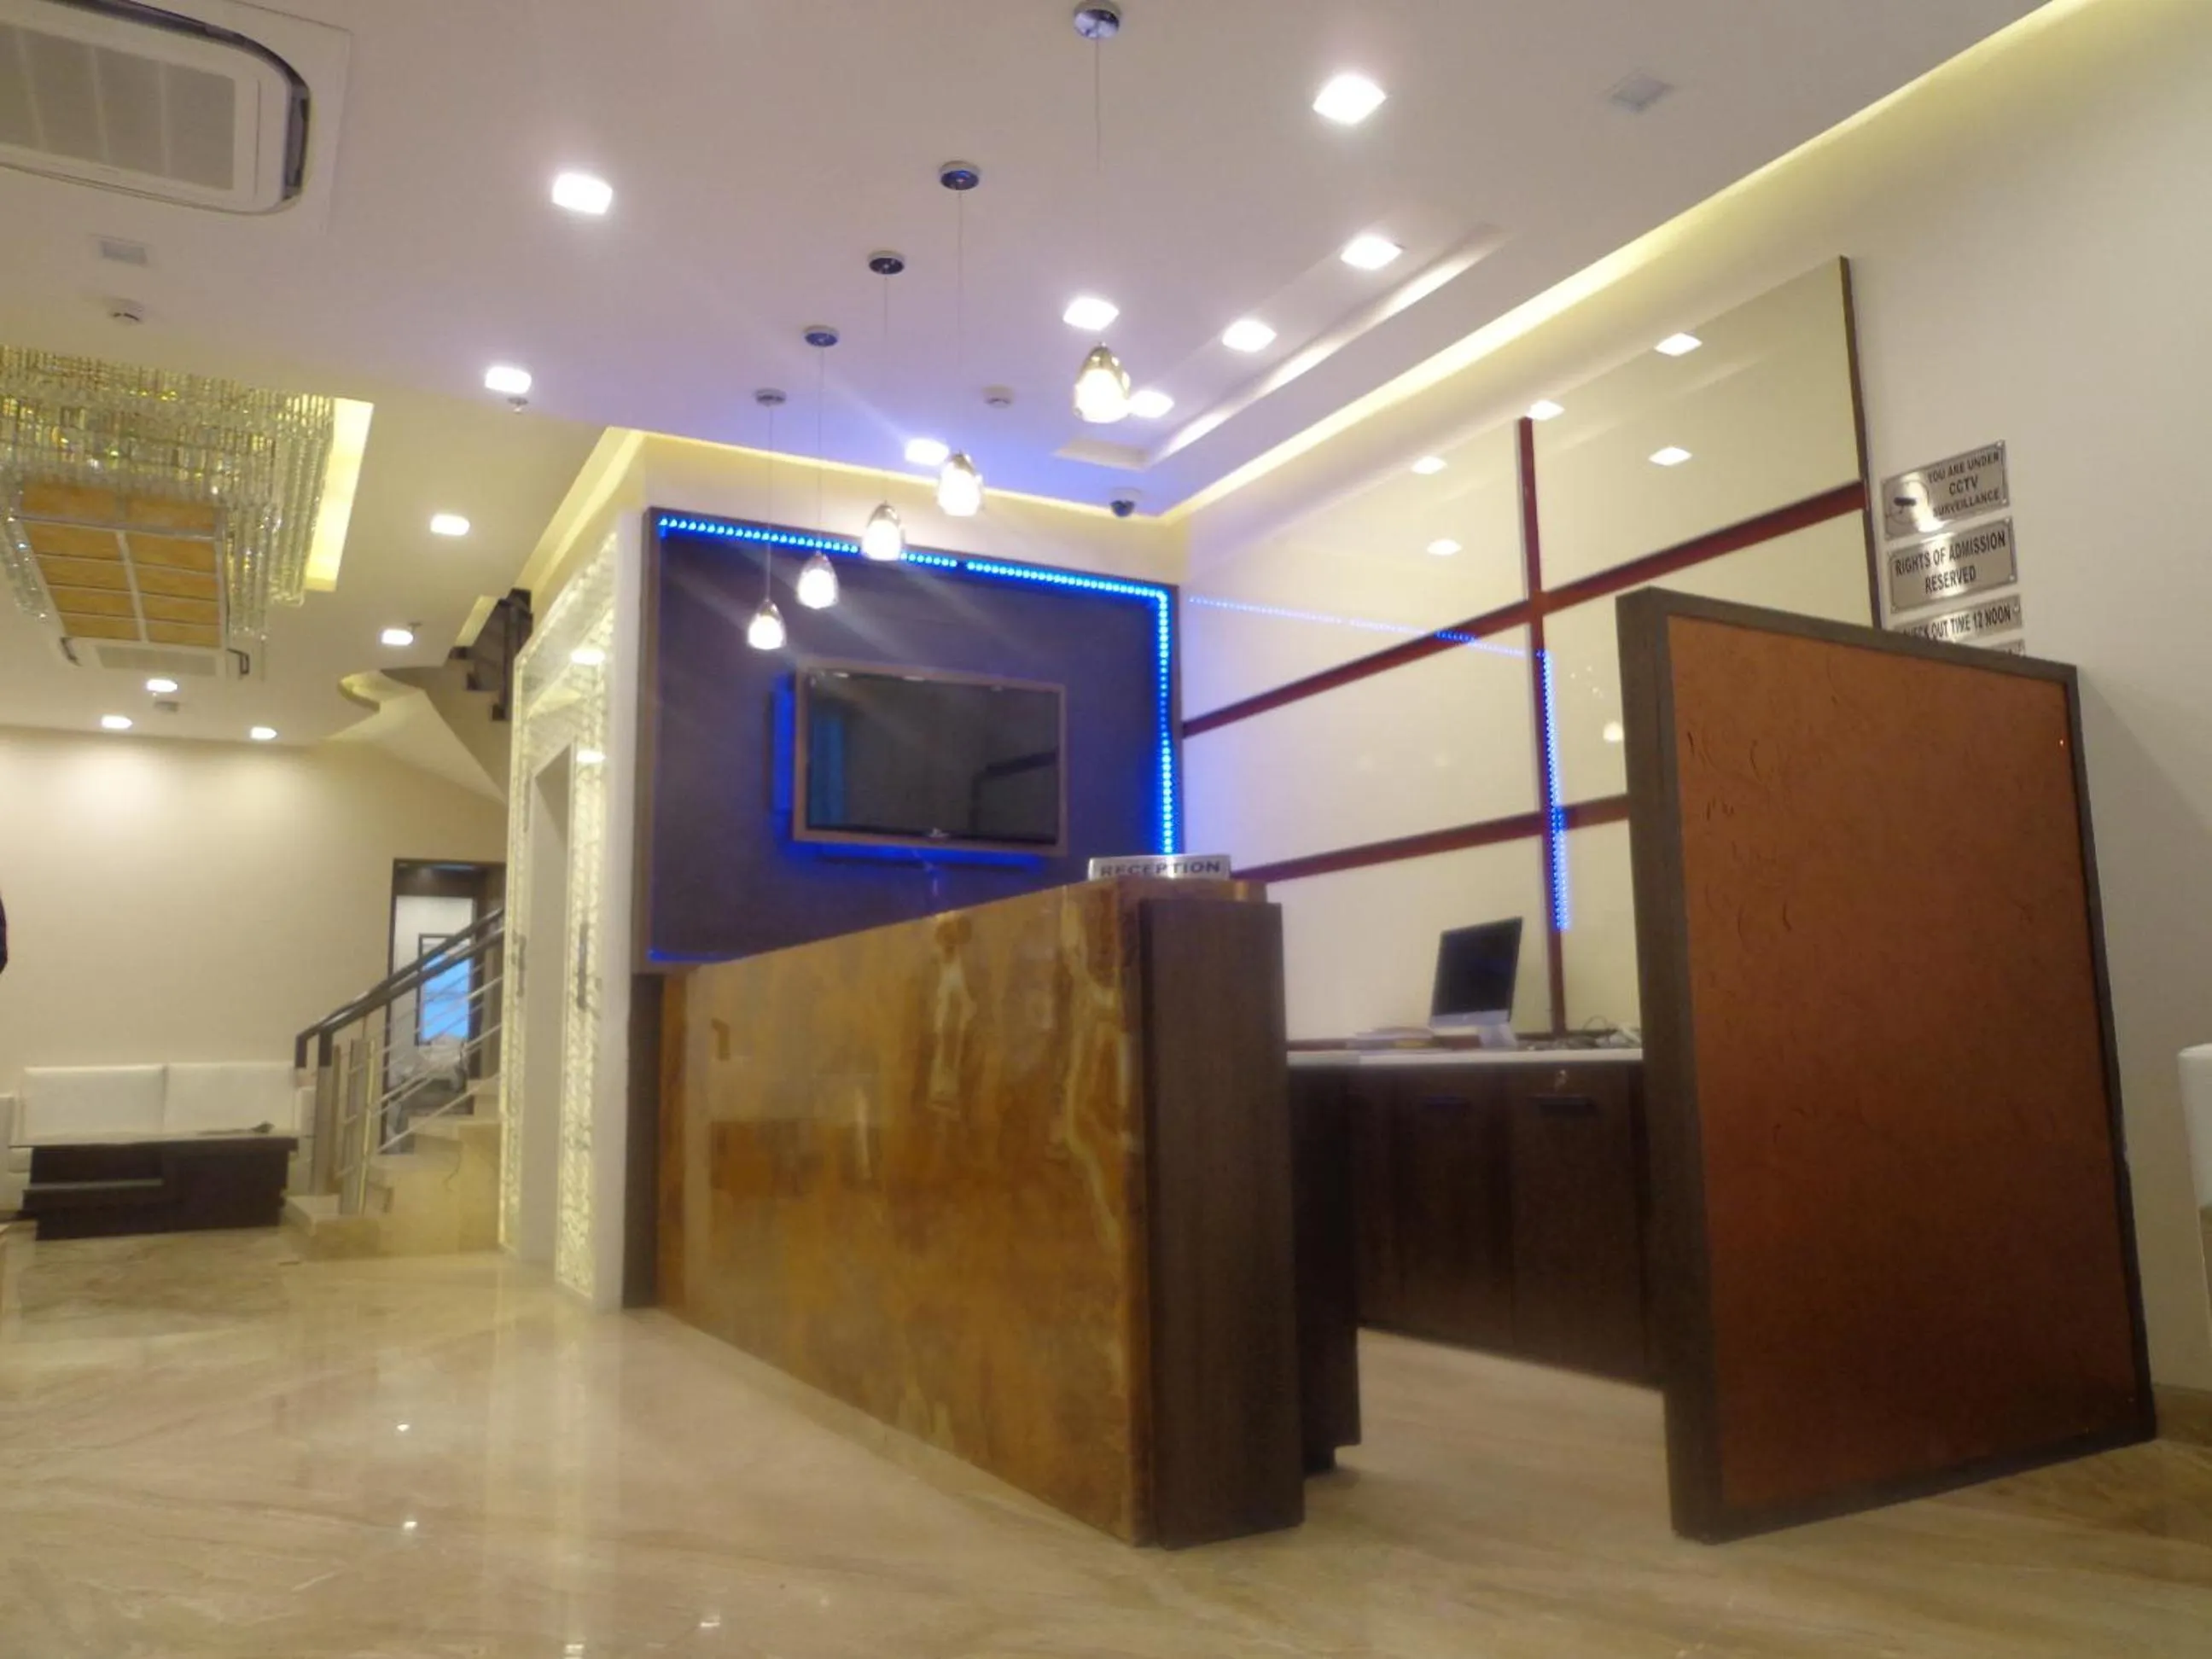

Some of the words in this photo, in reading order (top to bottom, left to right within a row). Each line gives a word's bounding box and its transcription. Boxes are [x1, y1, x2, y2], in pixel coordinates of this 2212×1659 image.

[1929, 469, 1945, 483] YOU
[1948, 462, 1964, 476] ARE
[1967, 451, 1999, 470] UNDER
[1949, 475, 1978, 495] CCTV
[1933, 488, 2000, 516] SURVEILLANCE
[1895, 551, 1930, 576] RIGHTS
[1933, 545, 1947, 565] OF
[1949, 530, 2005, 561] ADMISSION
[1925, 565, 1976, 594] RESERVED
[1931, 620, 1948, 638] OUT
[1950, 614, 1970, 634] TIME
[1973, 610, 1983, 628] 12
[1985, 604, 2011, 627] NOON
[1100, 860, 1220, 876] RECEPTION
